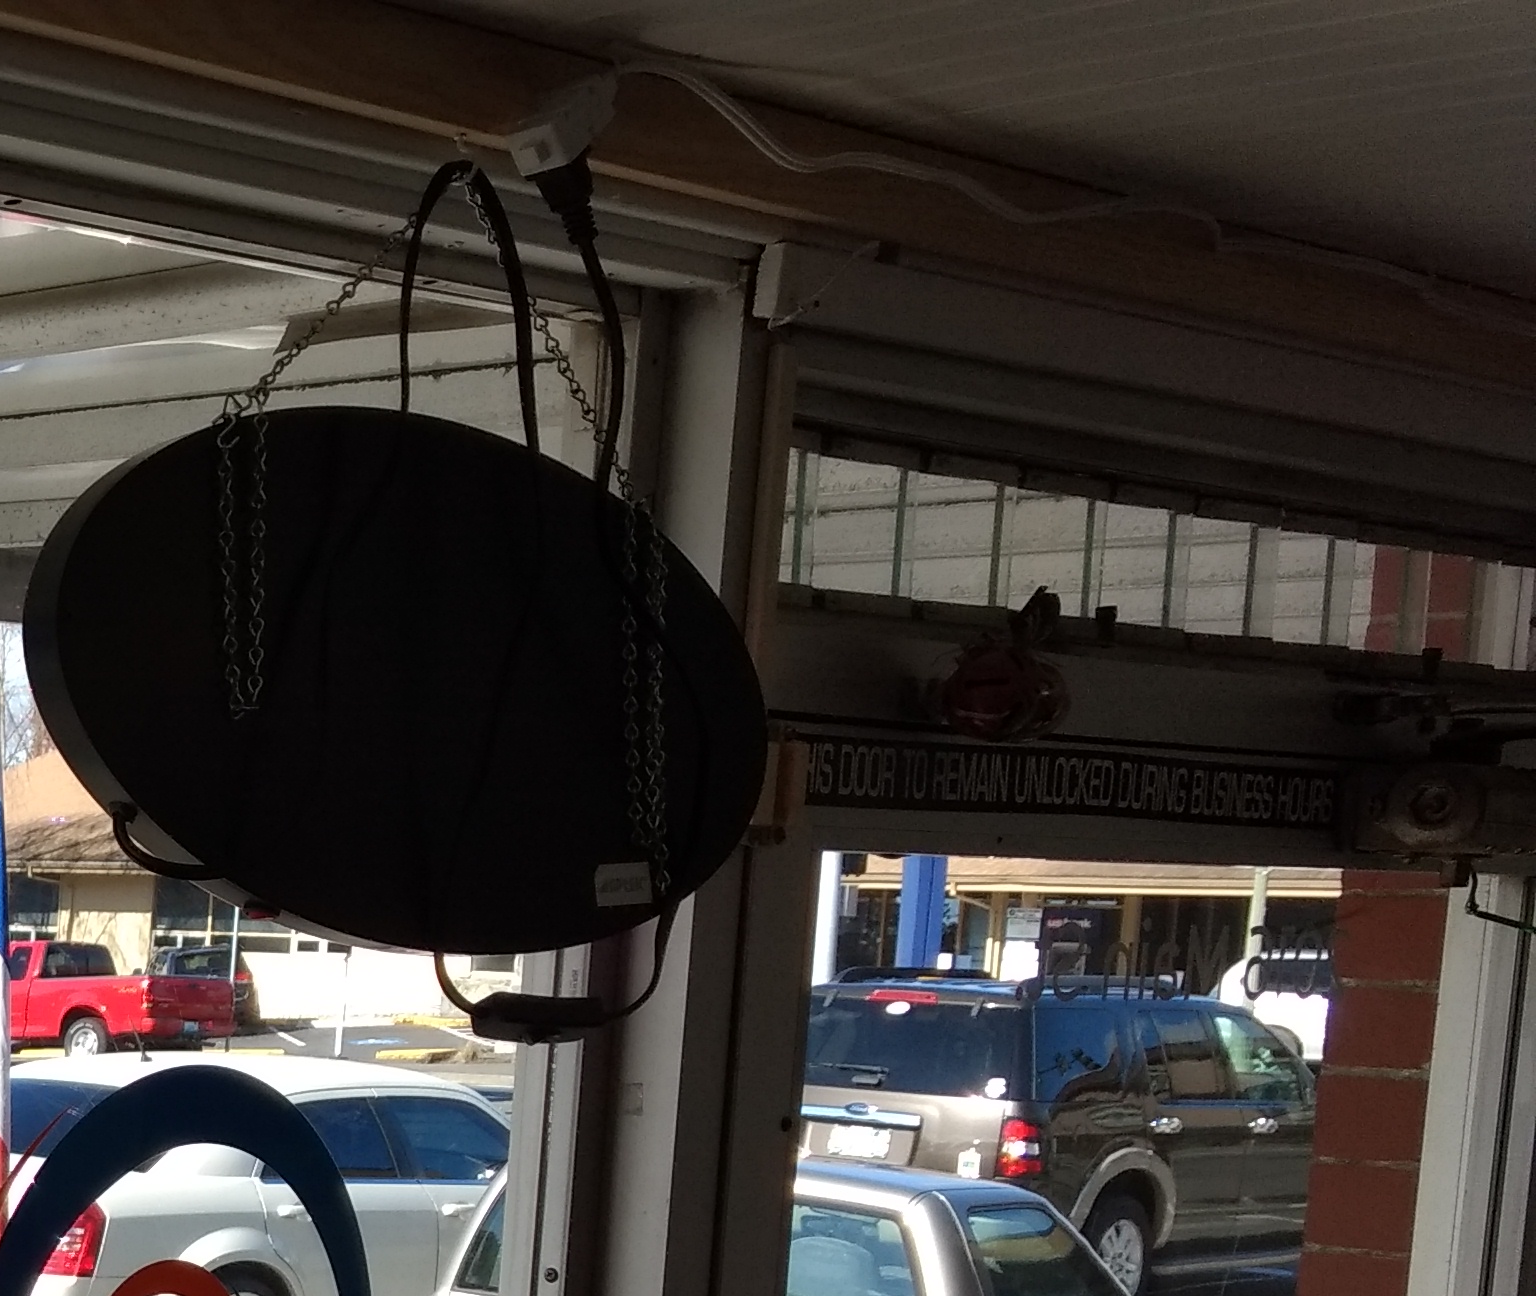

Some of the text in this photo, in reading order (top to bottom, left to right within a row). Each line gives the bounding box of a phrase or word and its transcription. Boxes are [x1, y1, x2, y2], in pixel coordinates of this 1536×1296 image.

[807, 743, 1335, 823] HIS DOOR TO REMAIN UNLOCKED DURING BUSINESS HOURS
